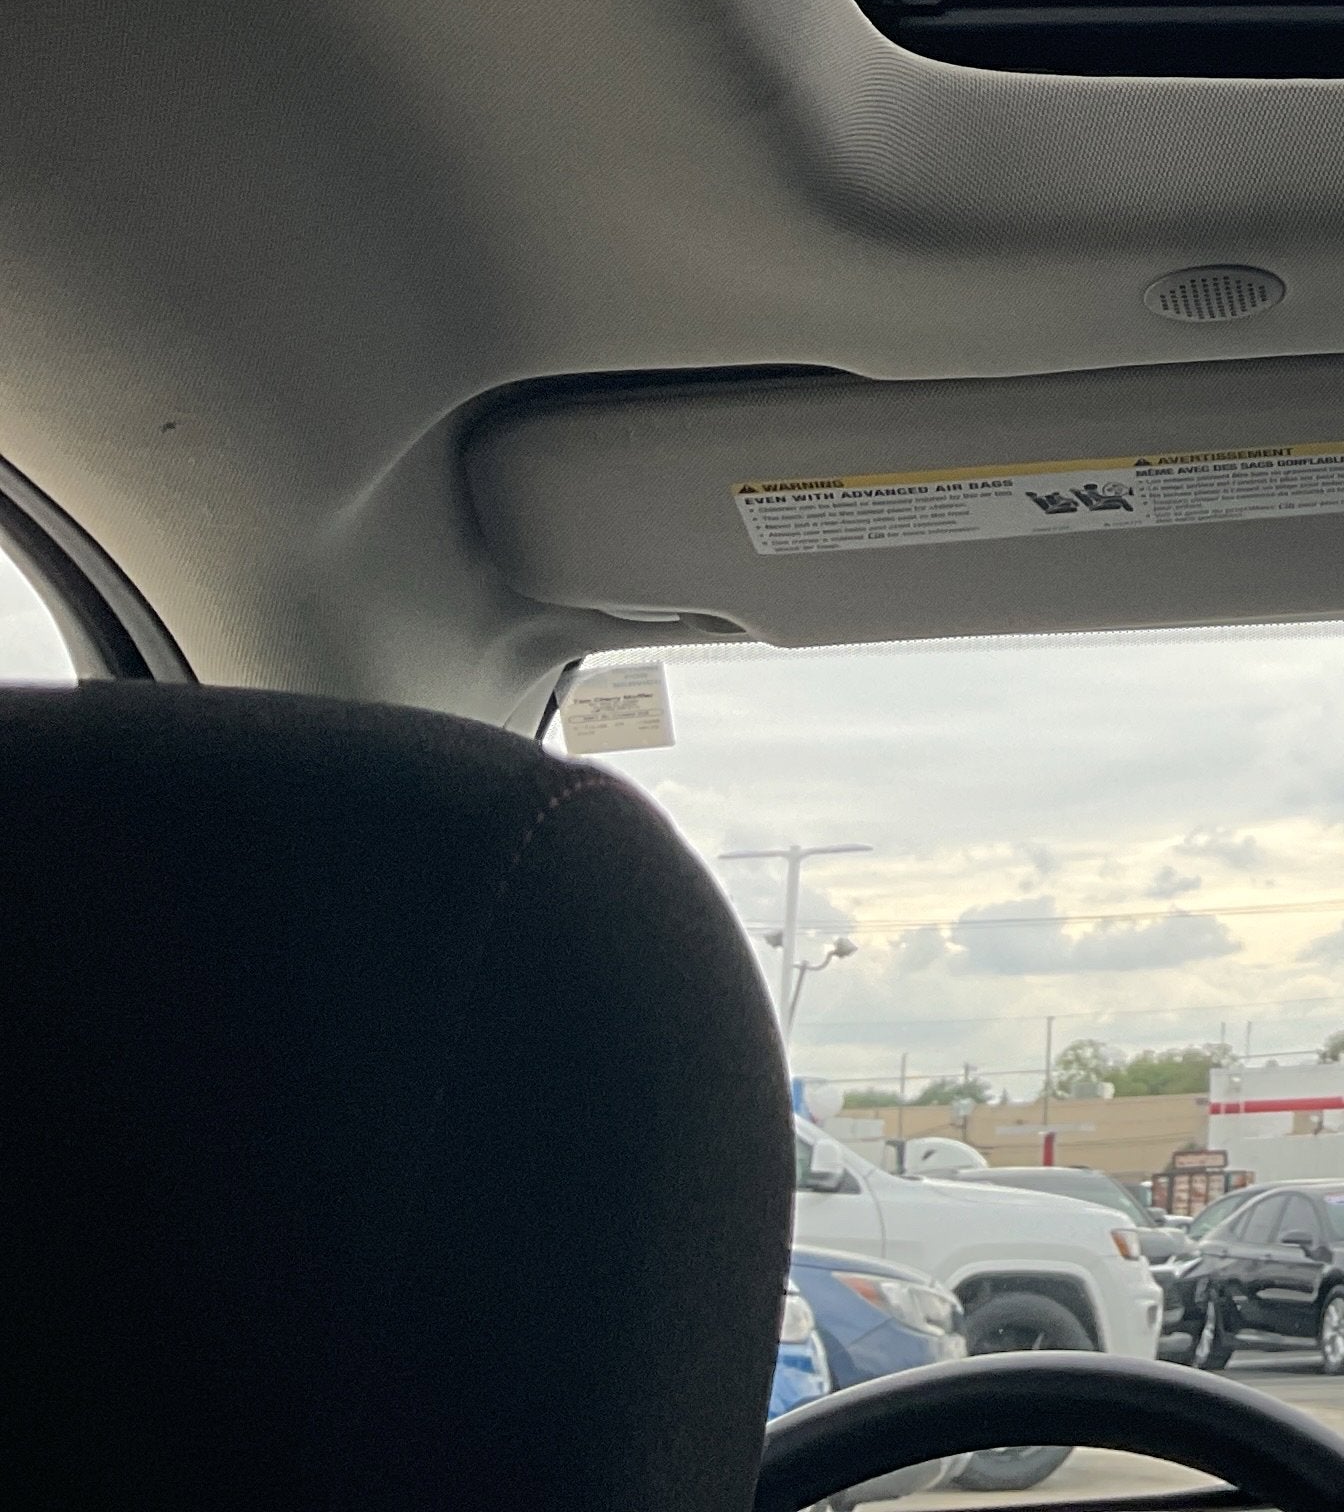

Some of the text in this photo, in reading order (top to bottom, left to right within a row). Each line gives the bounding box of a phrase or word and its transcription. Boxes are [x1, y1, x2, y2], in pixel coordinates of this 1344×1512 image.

[1158, 447, 1294, 465] AVERTISSEMENT
[1177, 464, 1210, 475] AVEC
[1213, 463, 1238, 473] DES
[744, 479, 1014, 506] EVEN WITH ADVANCED AIR BAGS
[762, 479, 845, 493] WARNING
